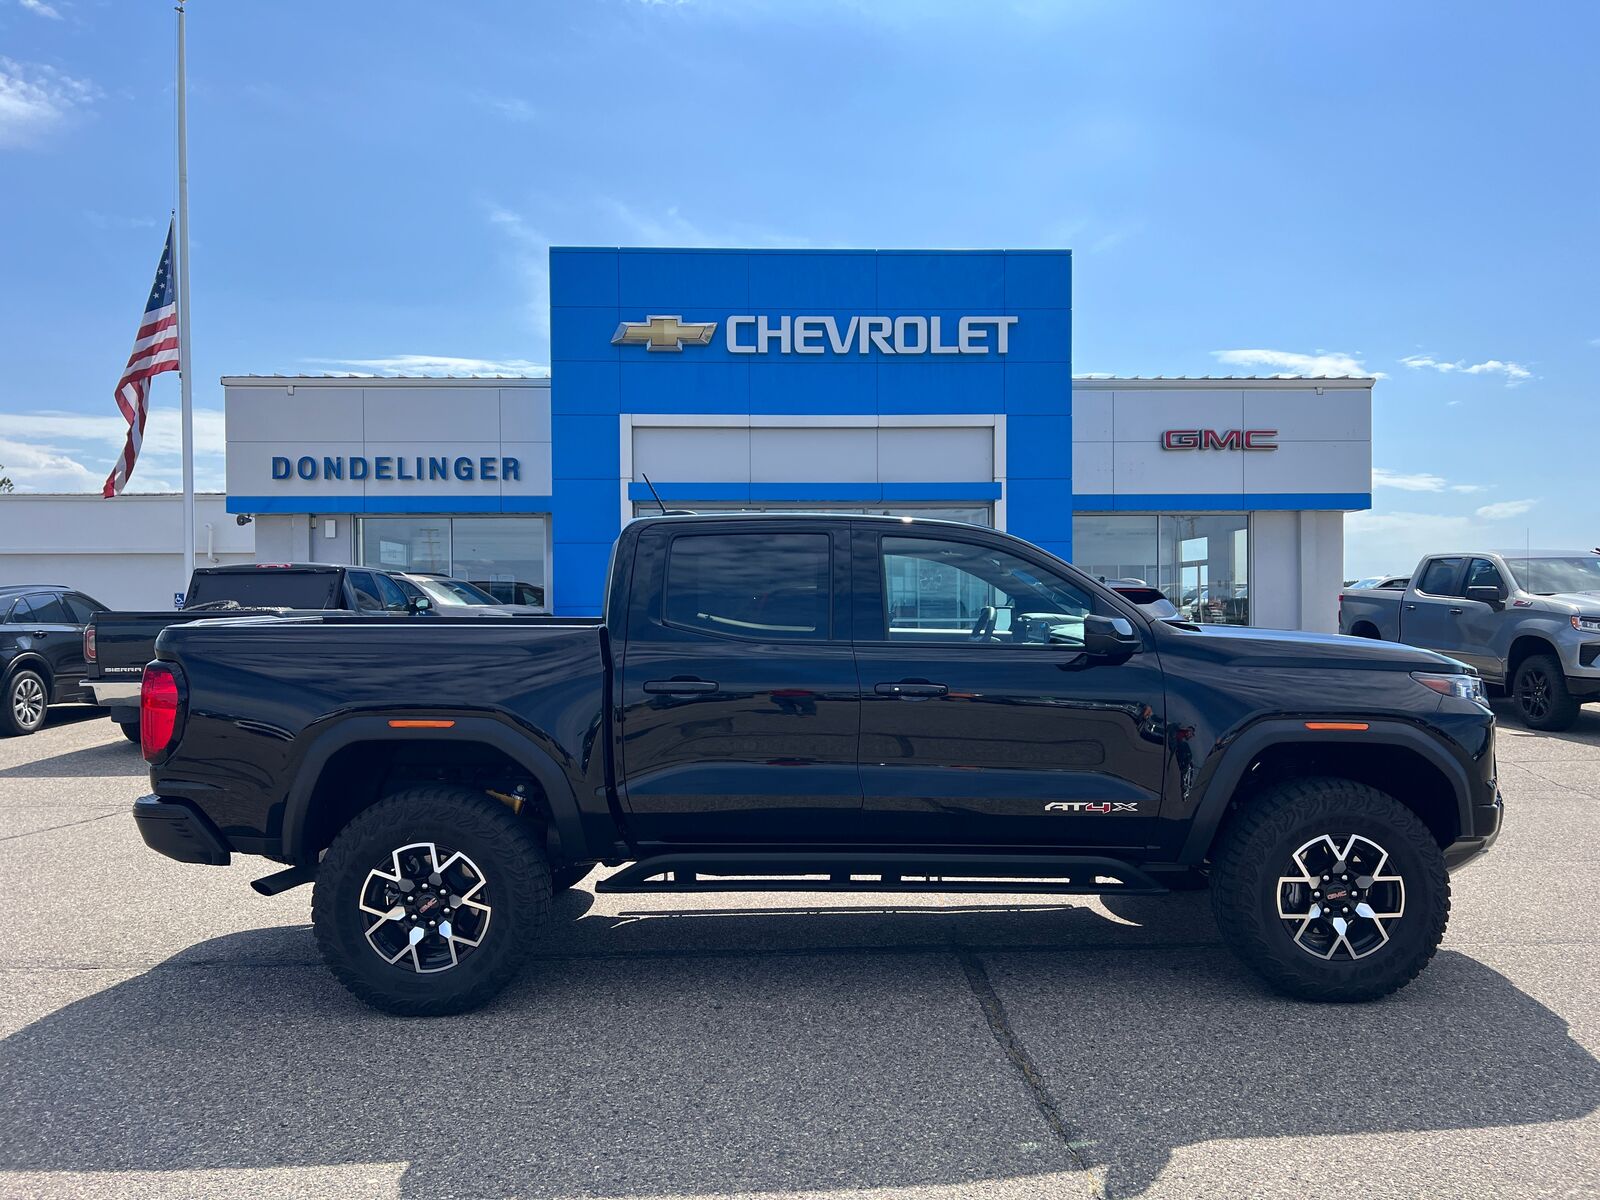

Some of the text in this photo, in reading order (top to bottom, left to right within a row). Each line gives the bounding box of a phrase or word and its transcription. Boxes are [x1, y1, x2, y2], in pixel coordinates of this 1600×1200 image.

[726, 315, 1019, 354] CHEVROLET
[1162, 429, 1278, 450] GMC
[271, 456, 521, 481] DONDELINGER
[1044, 802, 1138, 814] AT4X
[1327, 890, 1347, 900] GMC
